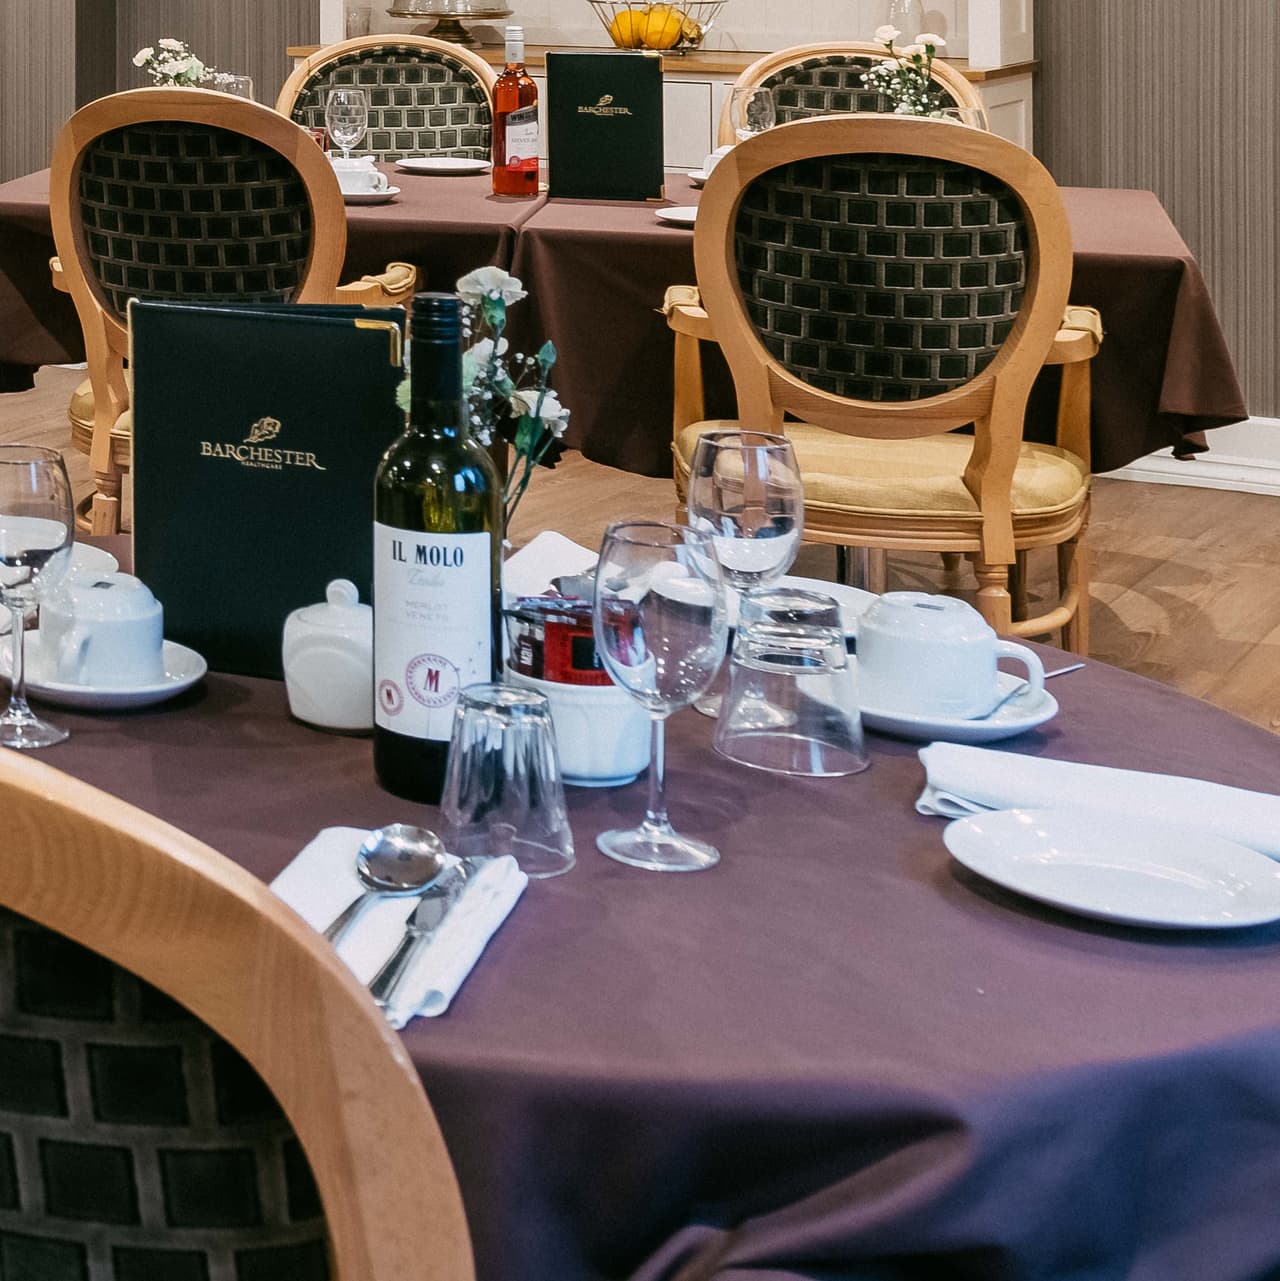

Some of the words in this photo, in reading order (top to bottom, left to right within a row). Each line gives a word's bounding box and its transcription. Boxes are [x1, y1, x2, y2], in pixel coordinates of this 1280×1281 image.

[577, 106, 632, 115] BARCHESTER
[200, 441, 327, 470] BARCHESTER
[241, 460, 282, 469] HEALTHCARE
[392, 540, 407, 562] IL
[416, 544, 464, 567] MOLO
[424, 667, 440, 693] M
